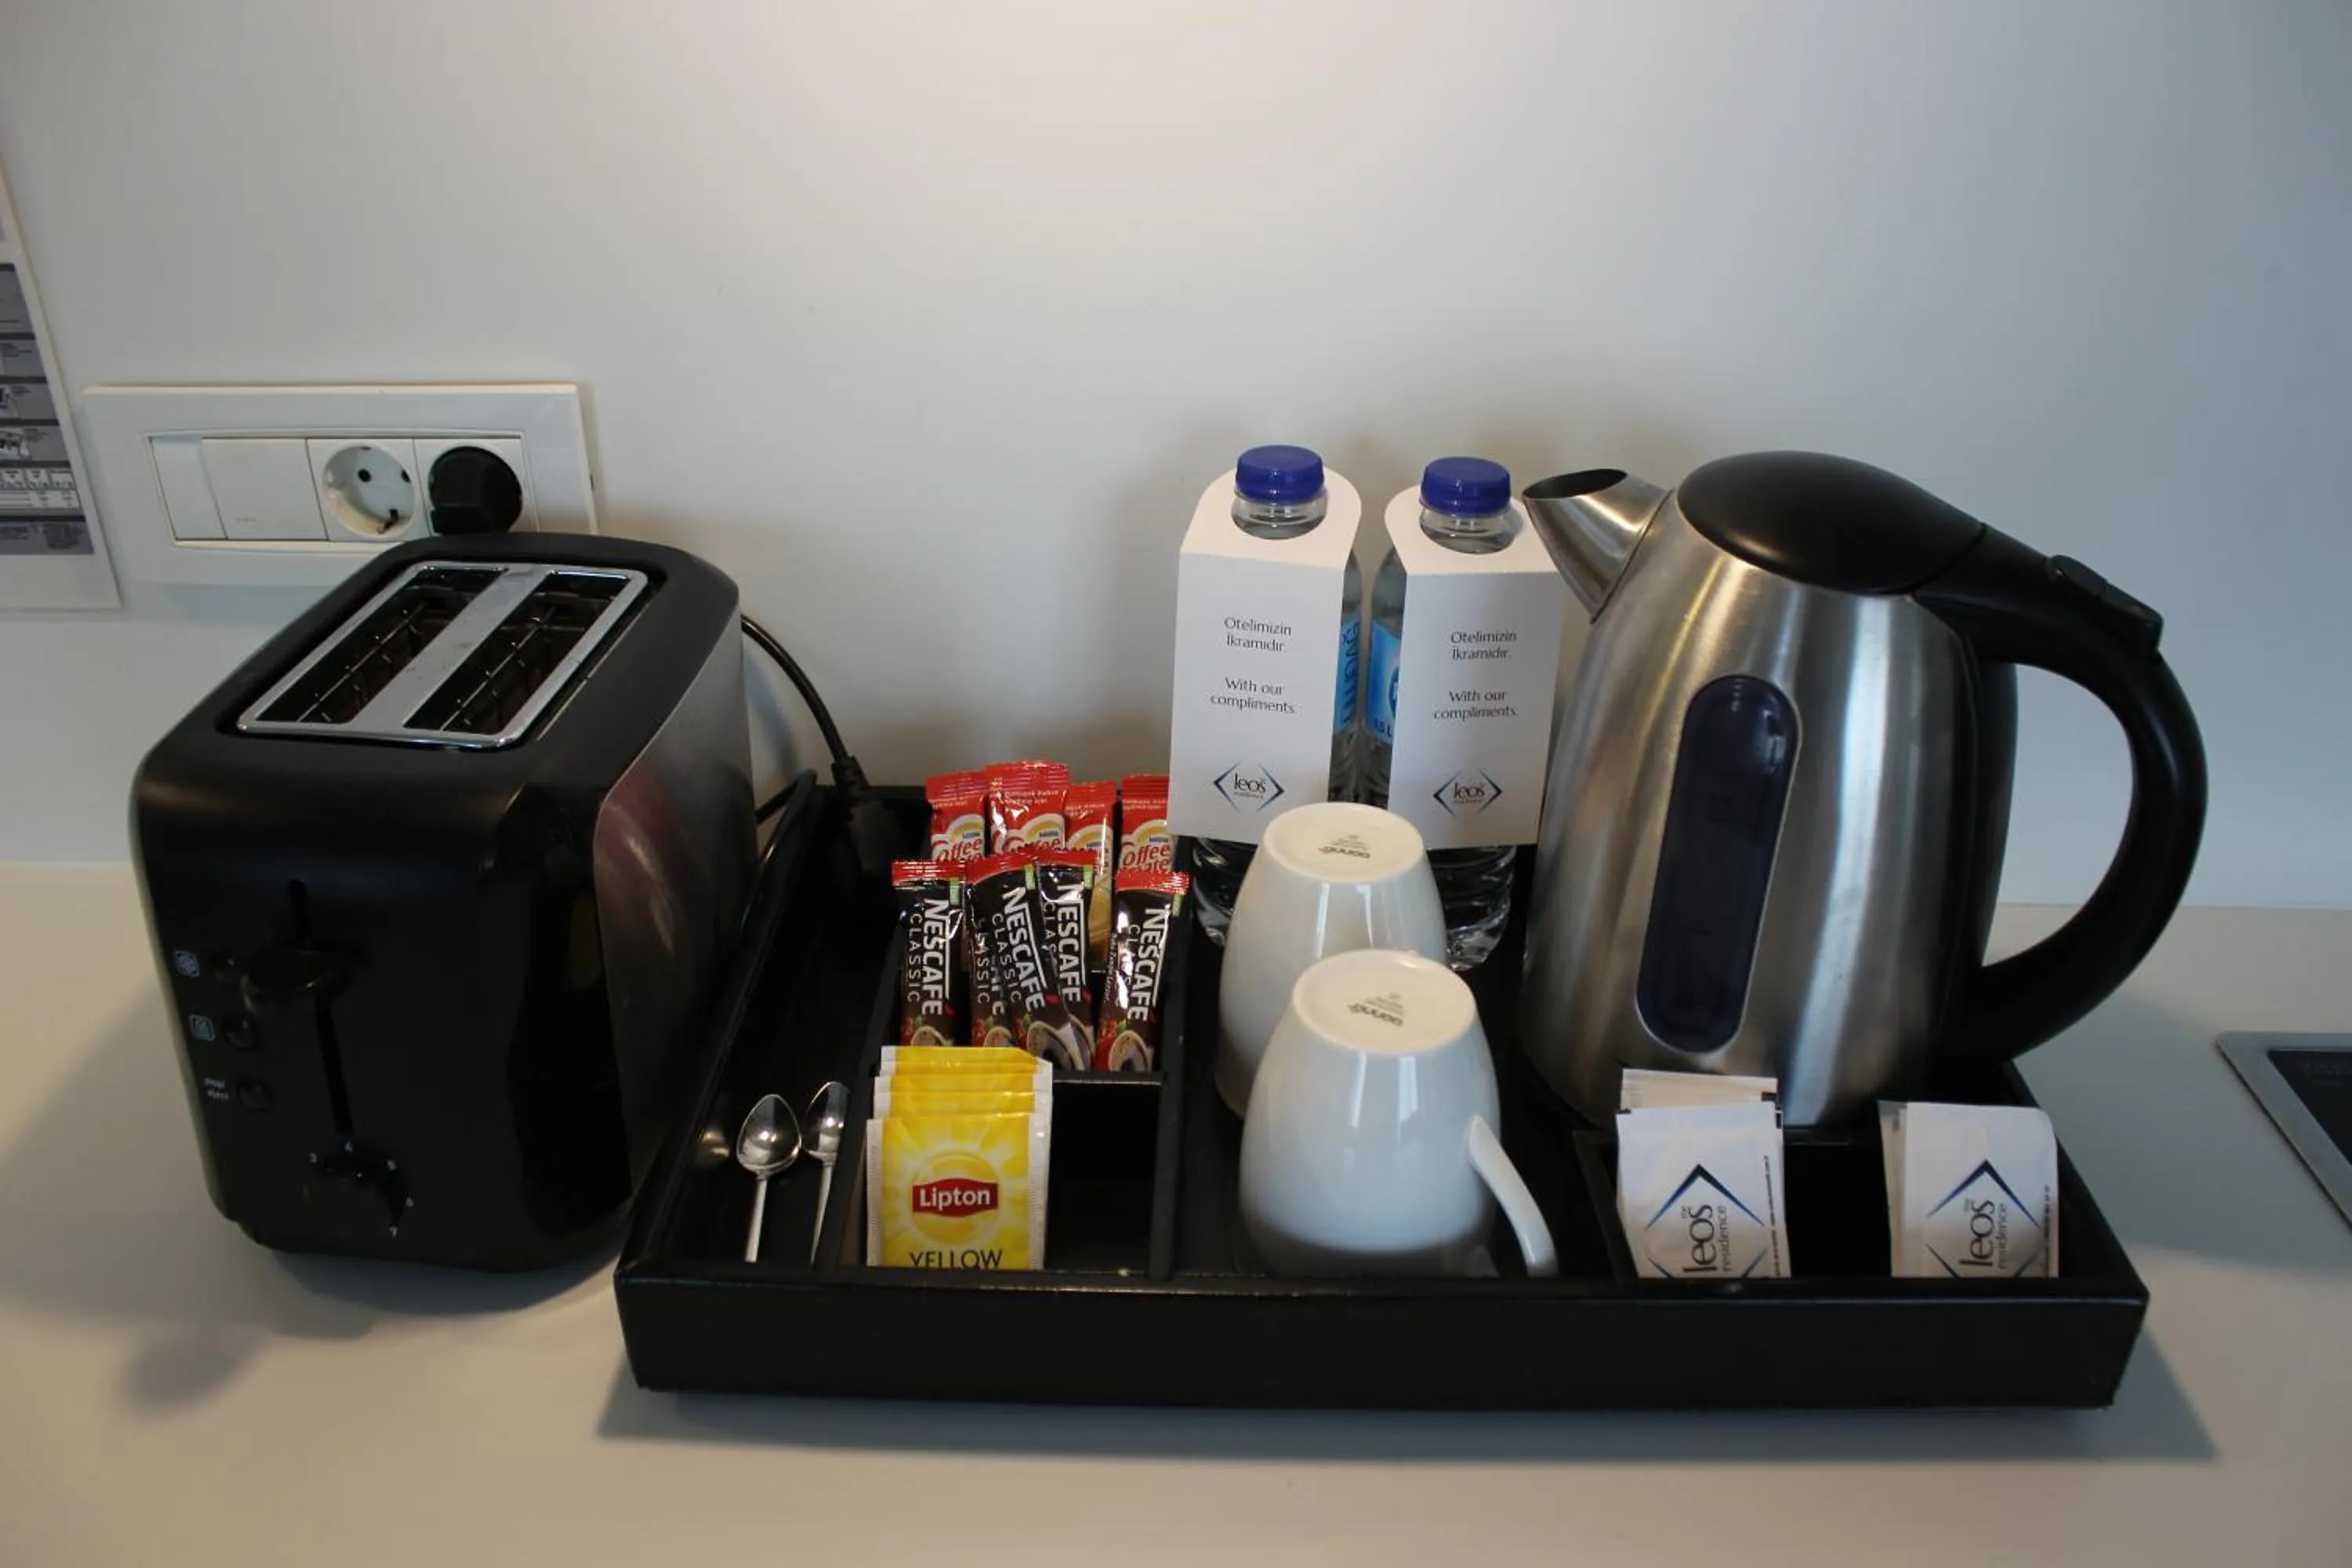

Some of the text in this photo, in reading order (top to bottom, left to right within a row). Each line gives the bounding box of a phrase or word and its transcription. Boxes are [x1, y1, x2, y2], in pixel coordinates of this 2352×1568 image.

[1224, 617, 1291, 636] Otelimizin
[1450, 631, 1518, 643] Otelimizin
[1225, 677, 1283, 695] With our
[1449, 690, 1508, 702] With our
[1234, 771, 1267, 793] leos
[907, 913, 923, 1003] CLASSIC
[991, 913, 1022, 1004] CLASSIC
[920, 1187, 991, 1211] Lipton
[1682, 1204, 1718, 1272] leos
[1959, 1200, 1995, 1267] leos
